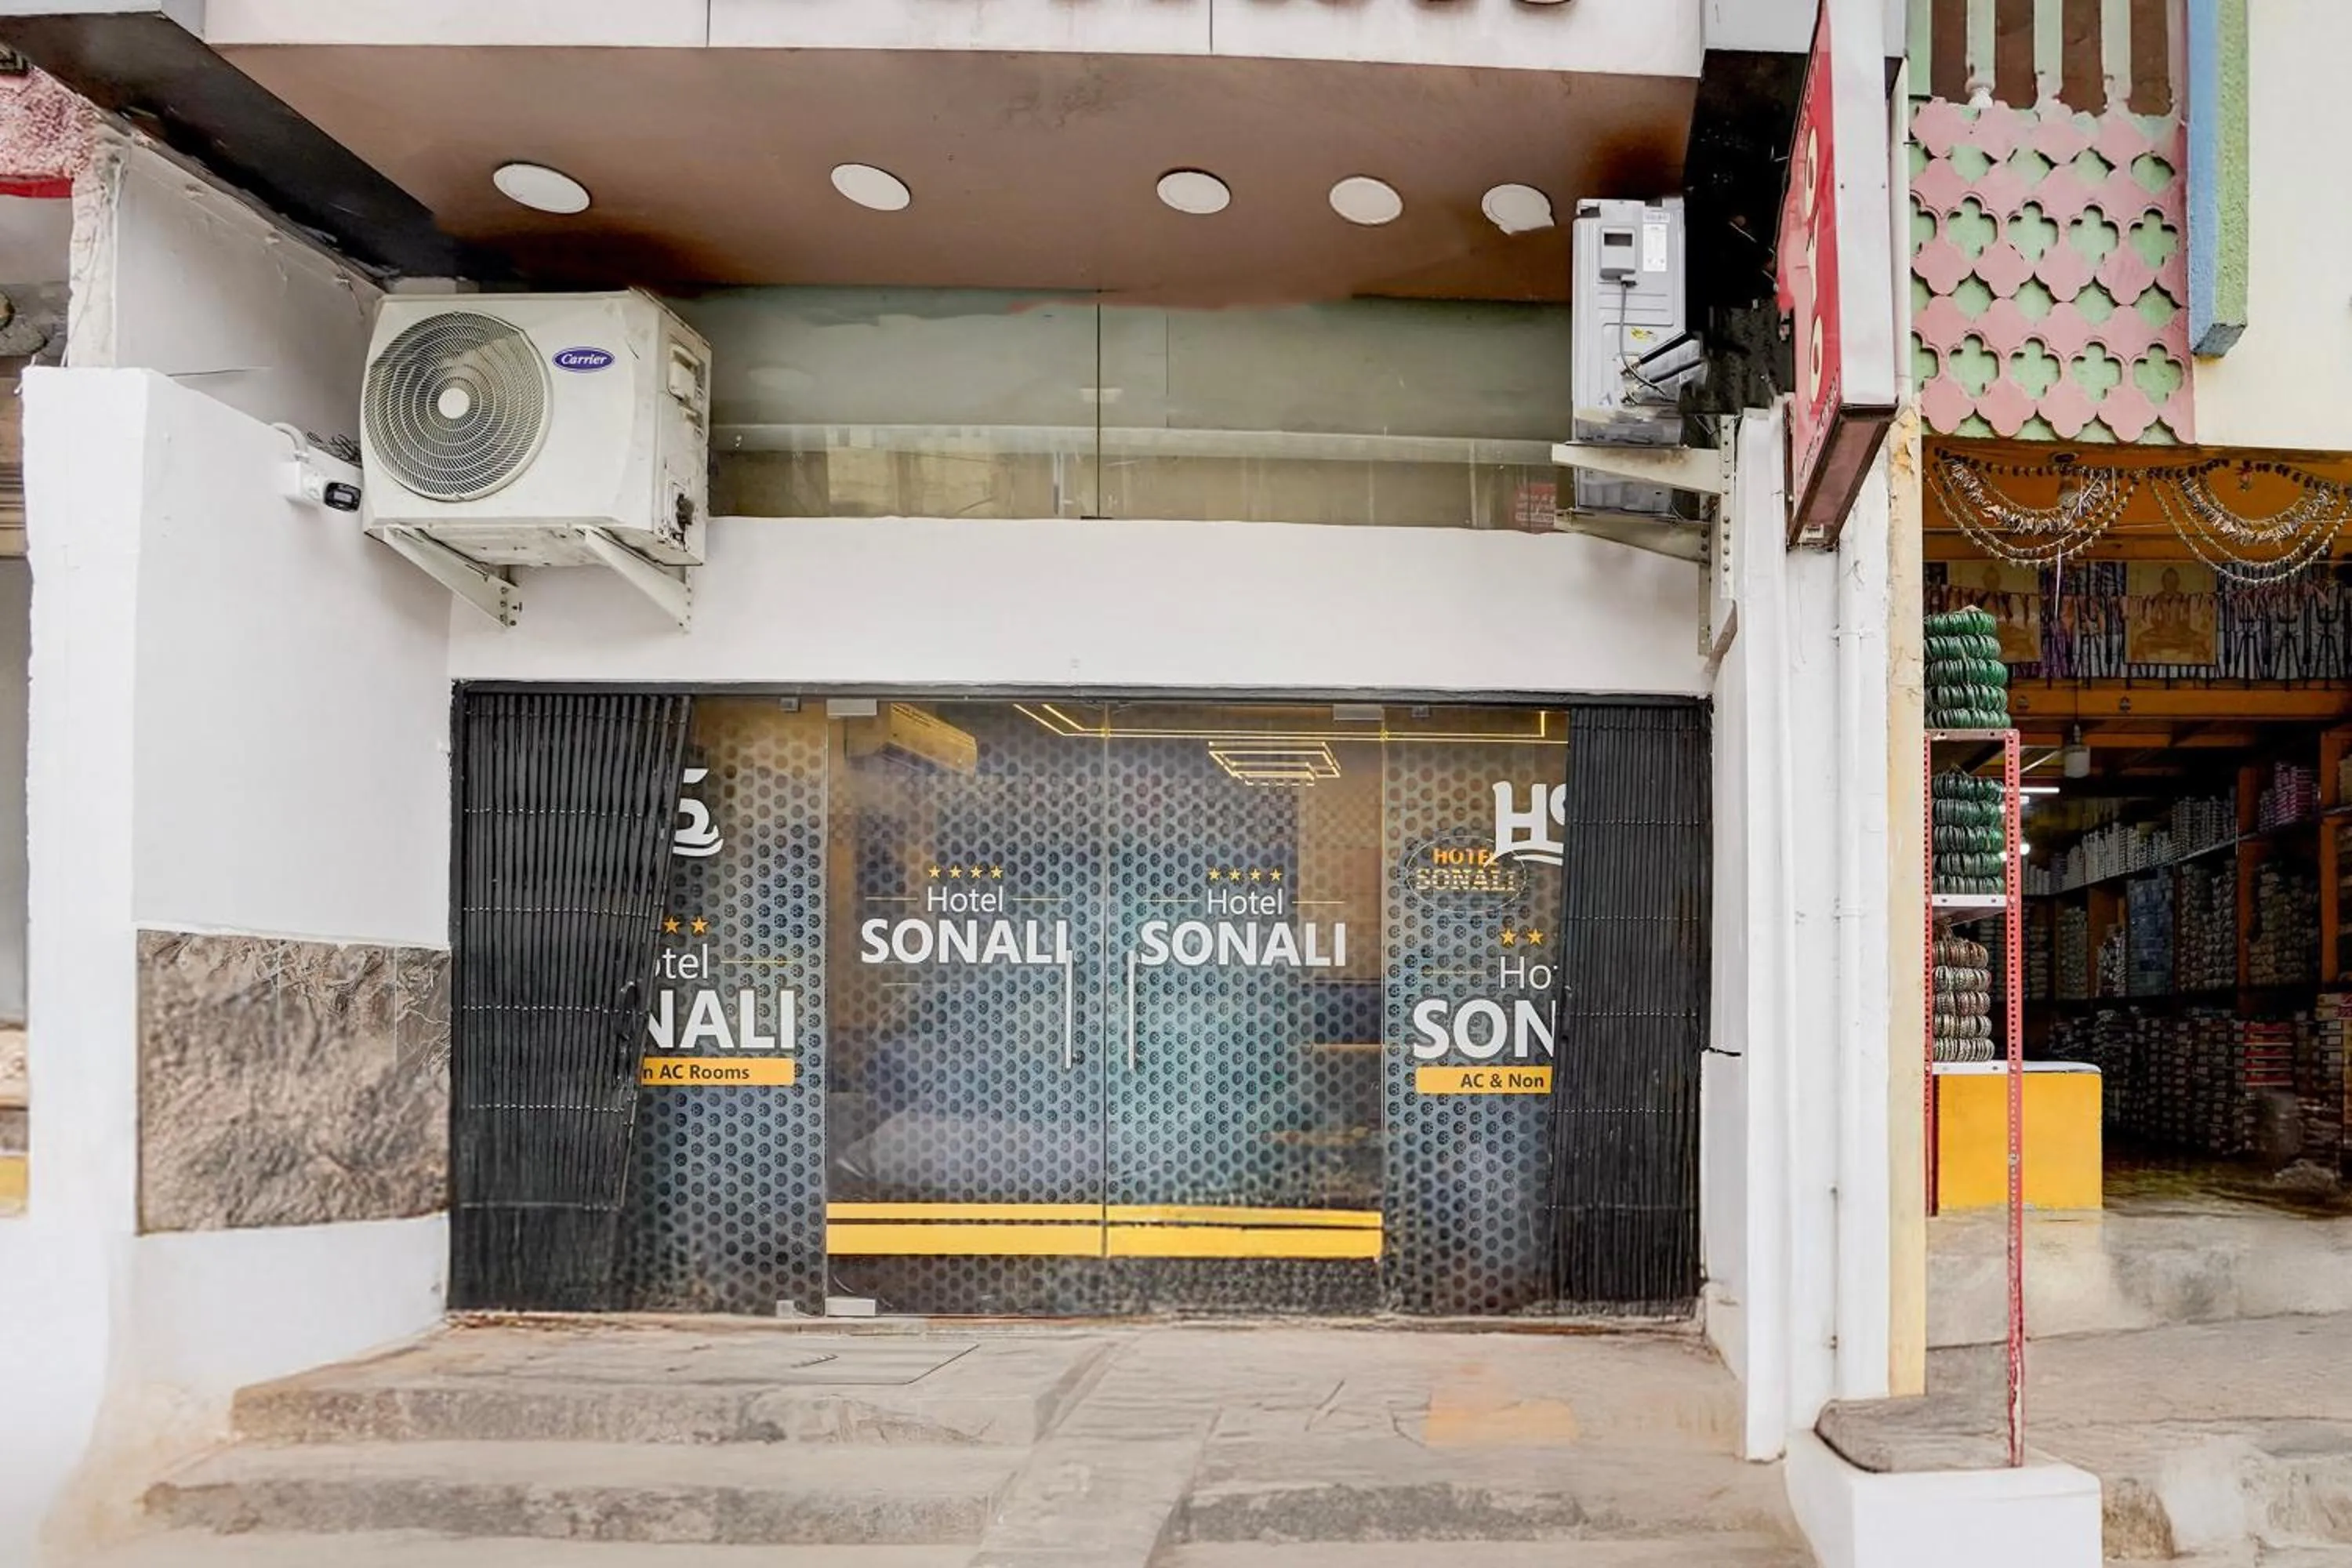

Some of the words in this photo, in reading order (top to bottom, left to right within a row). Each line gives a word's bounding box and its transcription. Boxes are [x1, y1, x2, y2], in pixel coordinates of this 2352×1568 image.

[561, 353, 608, 365] Carrier
[1416, 868, 1517, 891] SONALI
[927, 885, 1004, 913] Hotel
[1207, 888, 1283, 916] Hotel
[861, 918, 1068, 964] SONALI
[1140, 920, 1347, 967] SONALI
[655, 943, 709, 979] tel
[648, 989, 796, 1049] NALI
[1413, 998, 1557, 1059] SON
[659, 1065, 684, 1080] AC
[690, 1065, 750, 1080] Rooms
[1460, 1073, 1485, 1088] AC
[1490, 1073, 1503, 1088] &
[1508, 1073, 1544, 1088] Non
